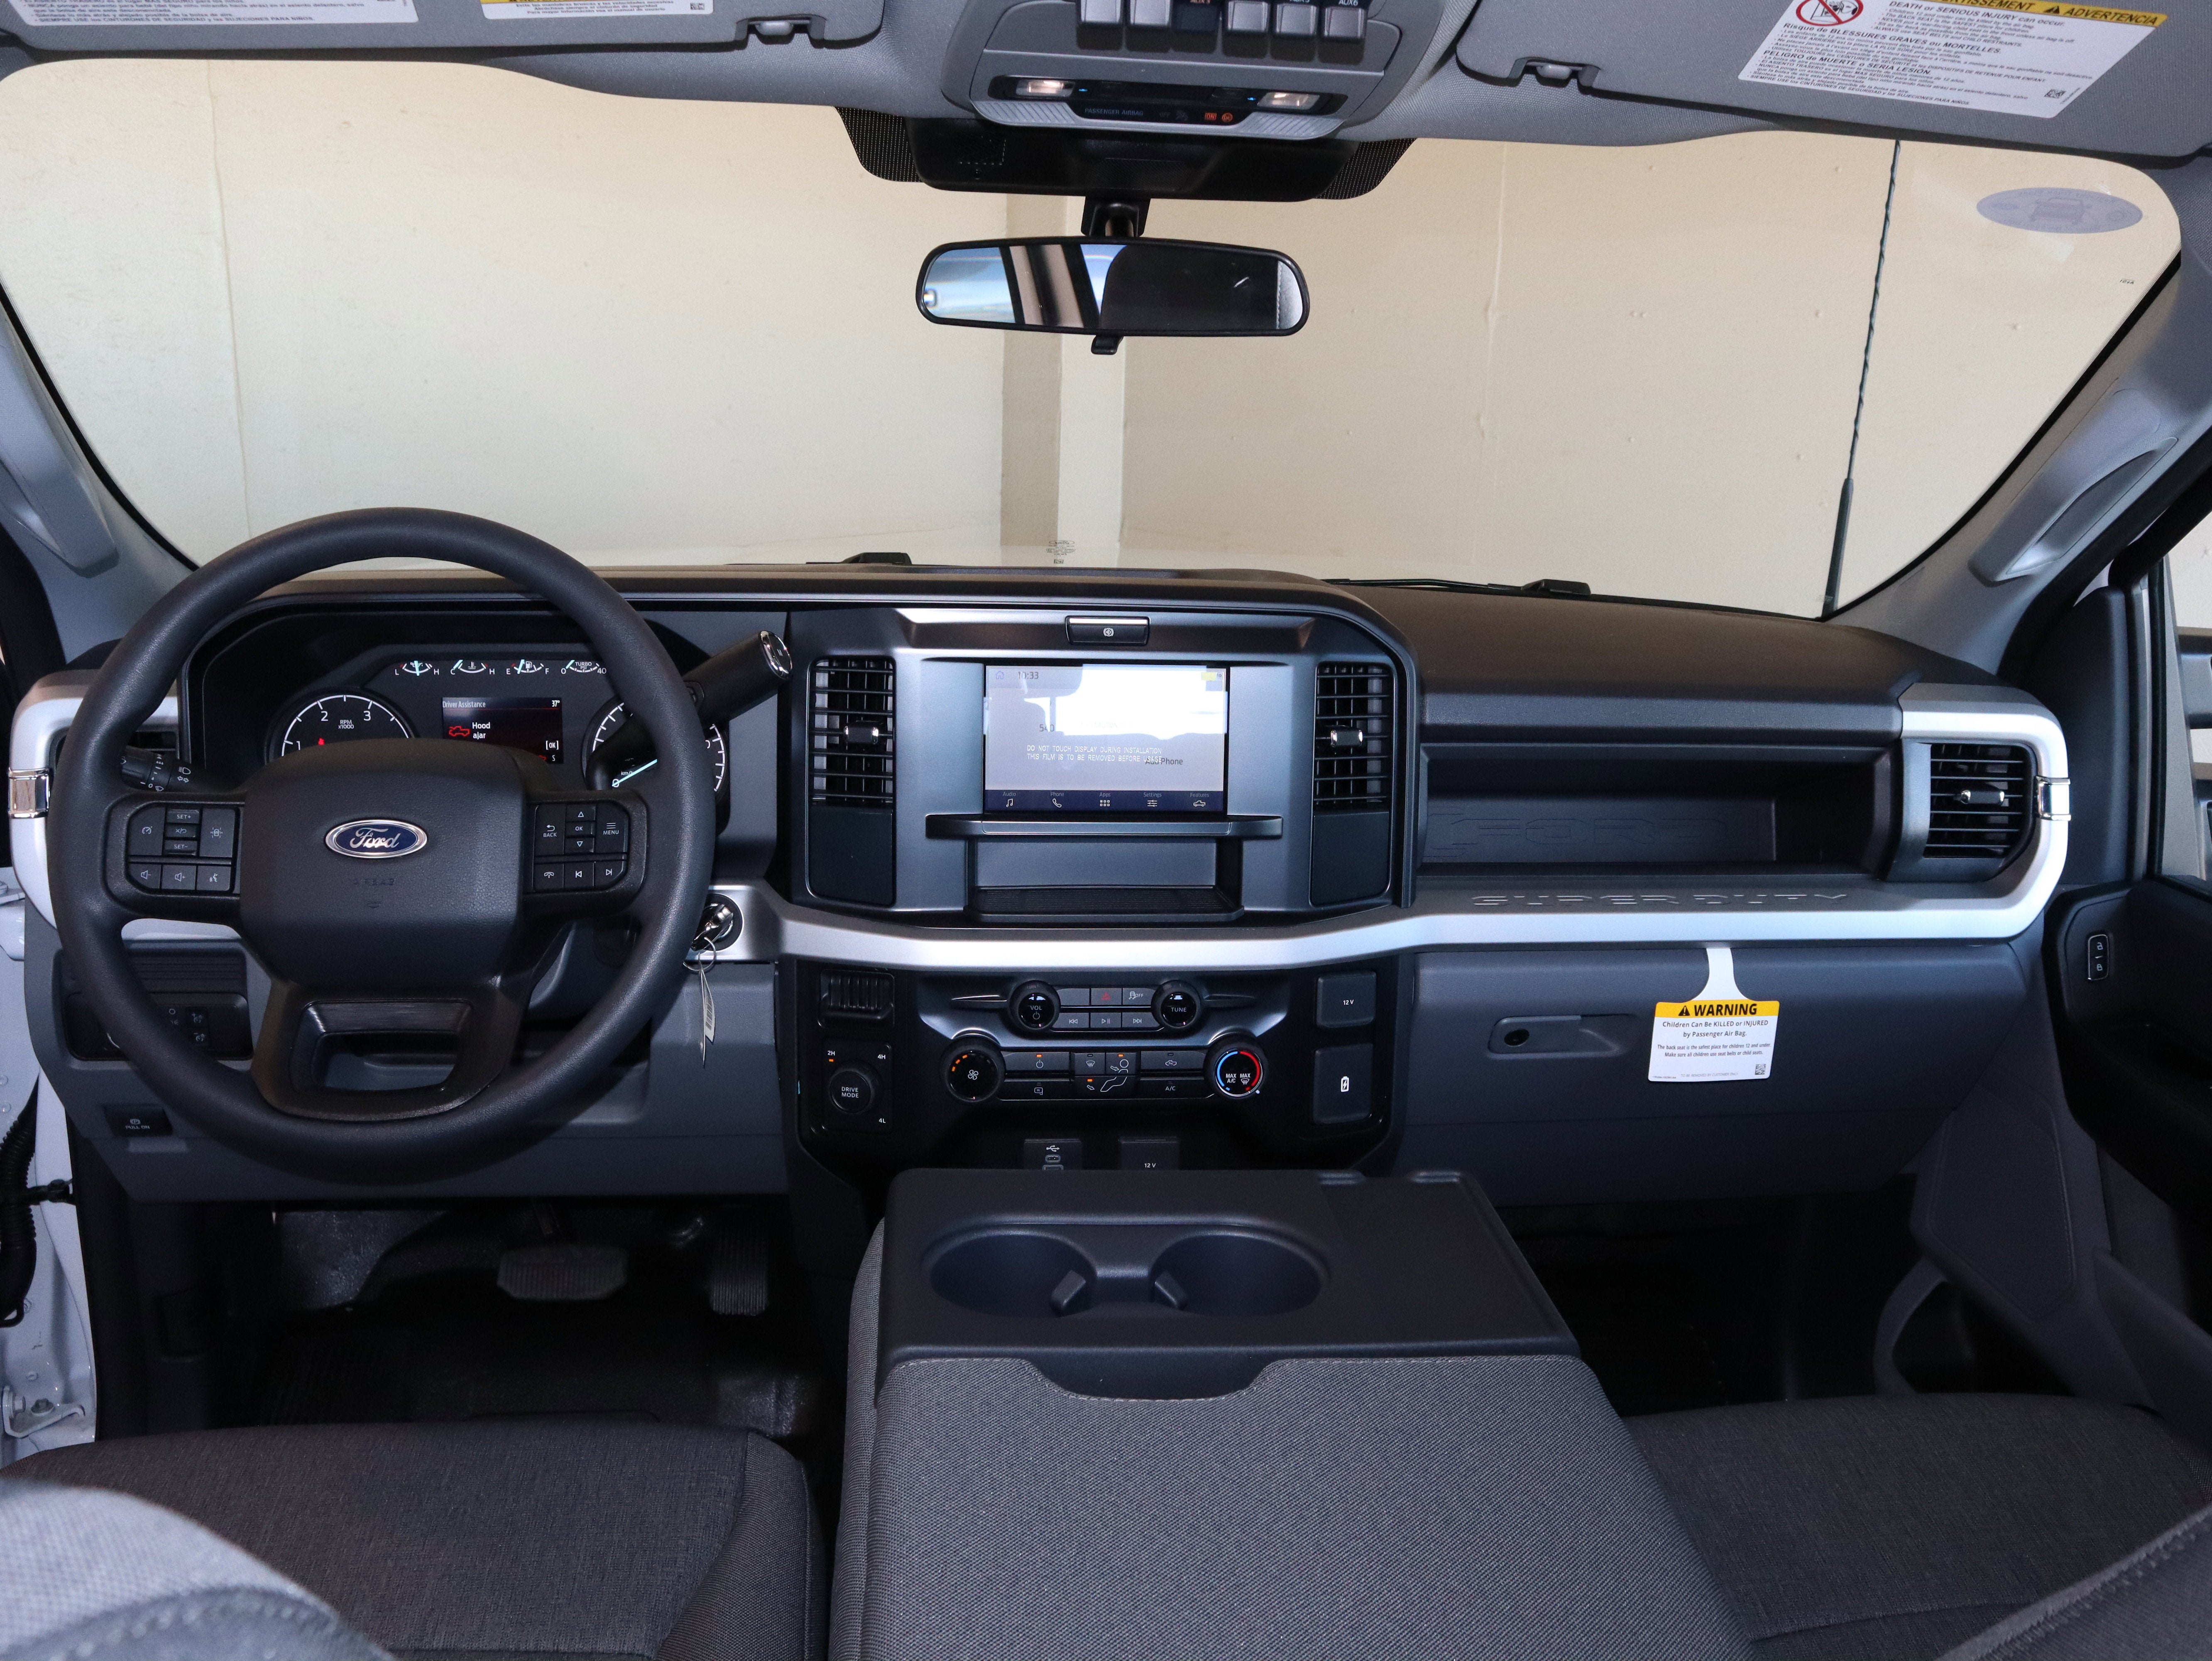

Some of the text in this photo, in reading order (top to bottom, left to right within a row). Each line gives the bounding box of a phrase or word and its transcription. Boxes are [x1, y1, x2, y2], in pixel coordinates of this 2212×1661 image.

[1888, 1, 1924, 10] DEATH
[1934, 6, 1981, 16] SERIOUS
[1980, 12, 2019, 20] INJURY
[2063, 8, 2158, 24] ADVERTENCIA
[1782, 23, 1816, 31] Risque
[1829, 29, 1888, 39] BLESSURES
[1888, 35, 1928, 44] GRAVES
[1942, 42, 2004, 53] MORTELLES.
[1763, 50, 1805, 59] PELIGRO
[1818, 56, 1857, 65] MUERTE
[321, 711, 328, 721] 2
[363, 710, 371, 721] 3
[296, 741, 301, 750] 1
[350, 828, 401, 848] Ford
[1471, 894, 1846, 905] SUPER DUTY
[1694, 1004, 1757, 1016] WARNING
